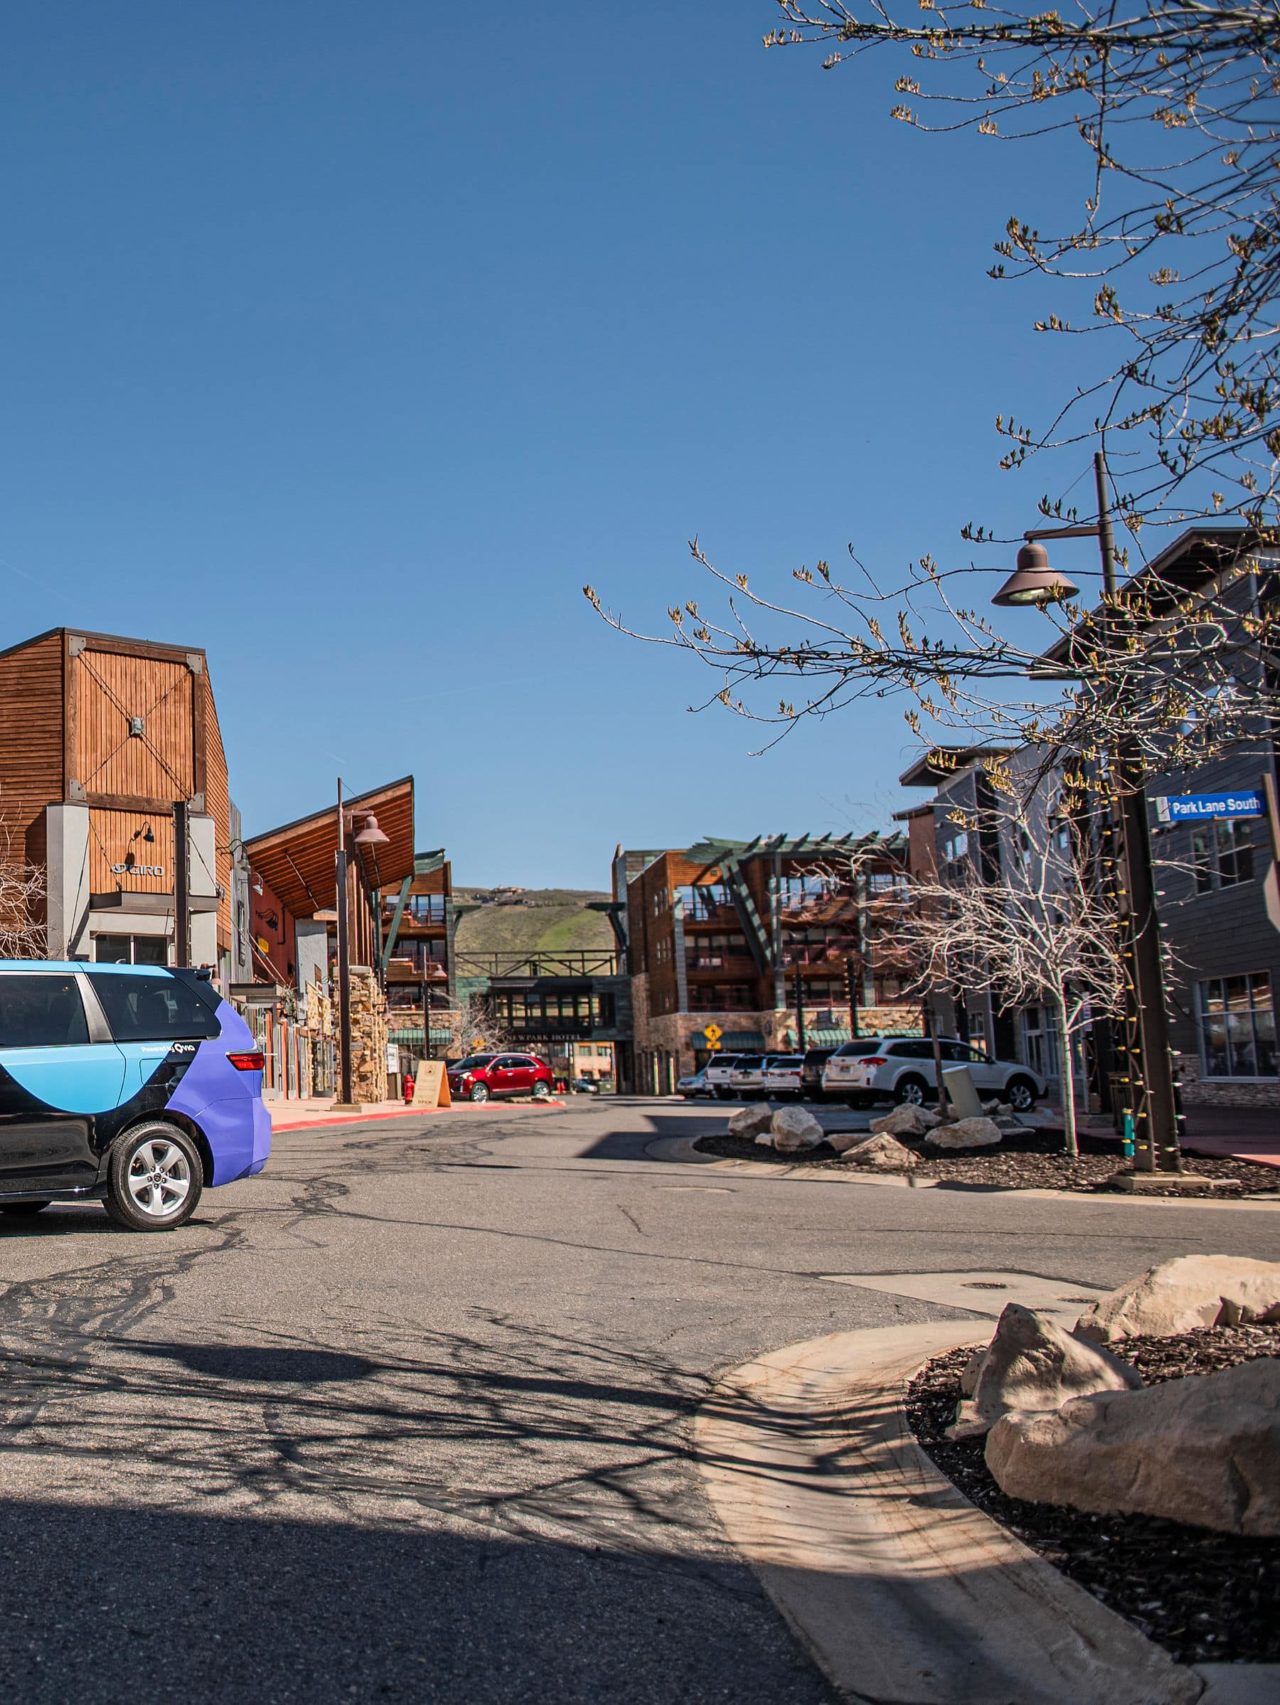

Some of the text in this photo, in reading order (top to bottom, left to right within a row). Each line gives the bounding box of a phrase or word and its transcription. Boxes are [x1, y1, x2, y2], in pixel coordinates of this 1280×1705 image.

[1173, 797, 1260, 814] Park Lane South
[130, 864, 165, 877] GIRO
[551, 1033, 583, 1041] HOTEL
